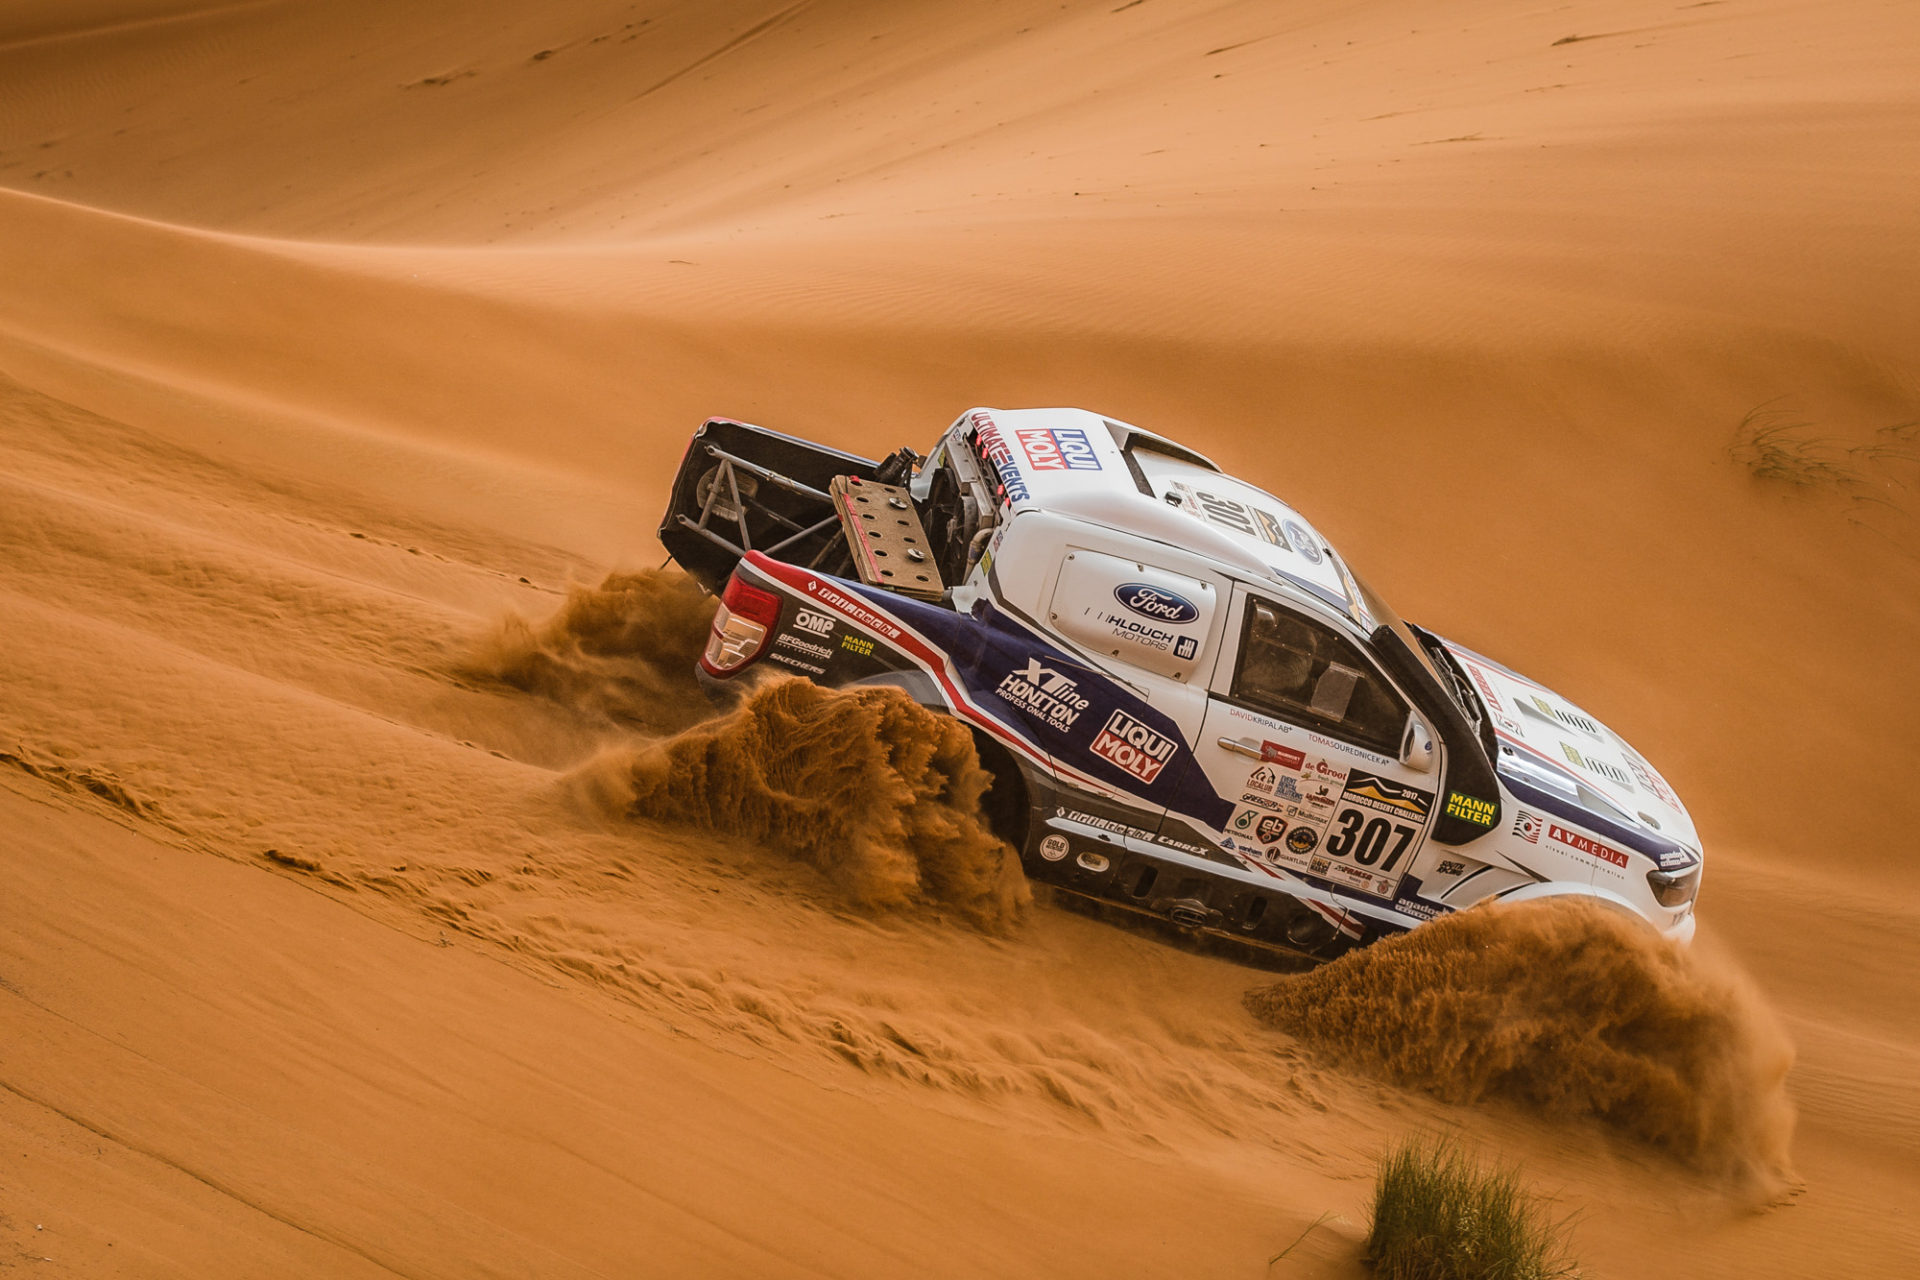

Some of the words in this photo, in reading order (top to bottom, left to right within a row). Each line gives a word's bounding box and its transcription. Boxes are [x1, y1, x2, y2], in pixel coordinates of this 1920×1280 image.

[1017, 429, 1066, 471] MOLY
[1052, 429, 1099, 471] LIQUI
[1130, 588, 1184, 619] Ford
[795, 611, 835, 635] OMP
[1108, 615, 1174, 643] HLOUCH
[778, 633, 834, 656] BFGoodrich
[841, 641, 872, 656] FILTER
[843, 634, 874, 650] MANN
[1112, 628, 1169, 651] MOTORS
[769, 653, 826, 675] SKECHERS
[999, 673, 1081, 726] HONITON
[1046, 716, 1071, 734] TOOLS
[1109, 714, 1173, 762] LIQUI
[1095, 733, 1162, 778] MOLY
[1305, 762, 1315, 771] de
[1316, 761, 1347, 781] Groot
[1401, 788, 1419, 801] 2017
[1450, 793, 1496, 815] MANN
[1342, 790, 1373, 807] MOROCCO
[1372, 800, 1395, 815] DESERT
[1393, 806, 1427, 824] CHALLENGE
[1447, 804, 1492, 826] FILTER
[1047, 839, 1065, 849] GOLD
[1224, 828, 1254, 841] PETRONAS
[1326, 808, 1417, 872] 307
